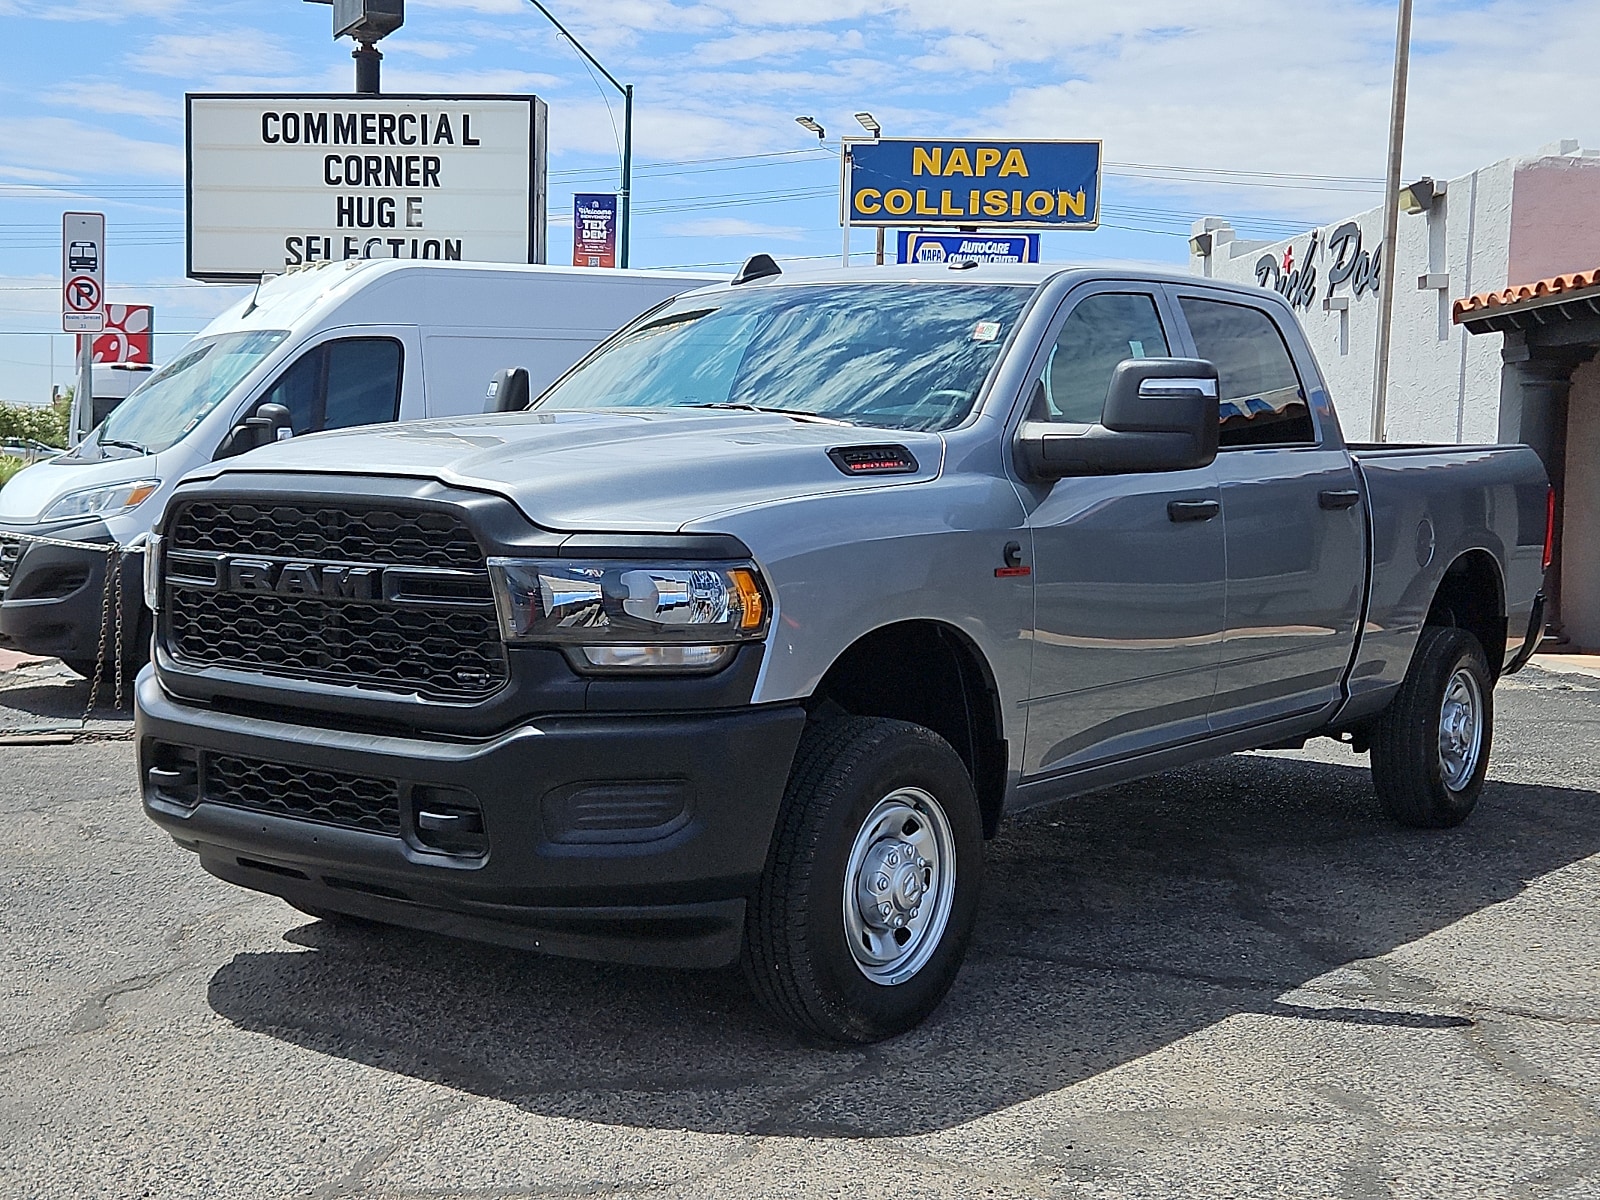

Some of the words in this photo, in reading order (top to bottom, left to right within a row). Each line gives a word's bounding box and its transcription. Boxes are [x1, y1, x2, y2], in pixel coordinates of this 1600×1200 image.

[261, 112, 481, 146] COMMERCIAL
[323, 154, 441, 188] CORNER
[912, 147, 1029, 177] NAPA
[336, 196, 424, 229] HUGE
[854, 188, 1086, 217] COLLISION
[583, 220, 607, 230] TEX
[583, 230, 607, 239] DEM
[921, 248, 943, 262] NAPA
[229, 558, 378, 601] RAM
